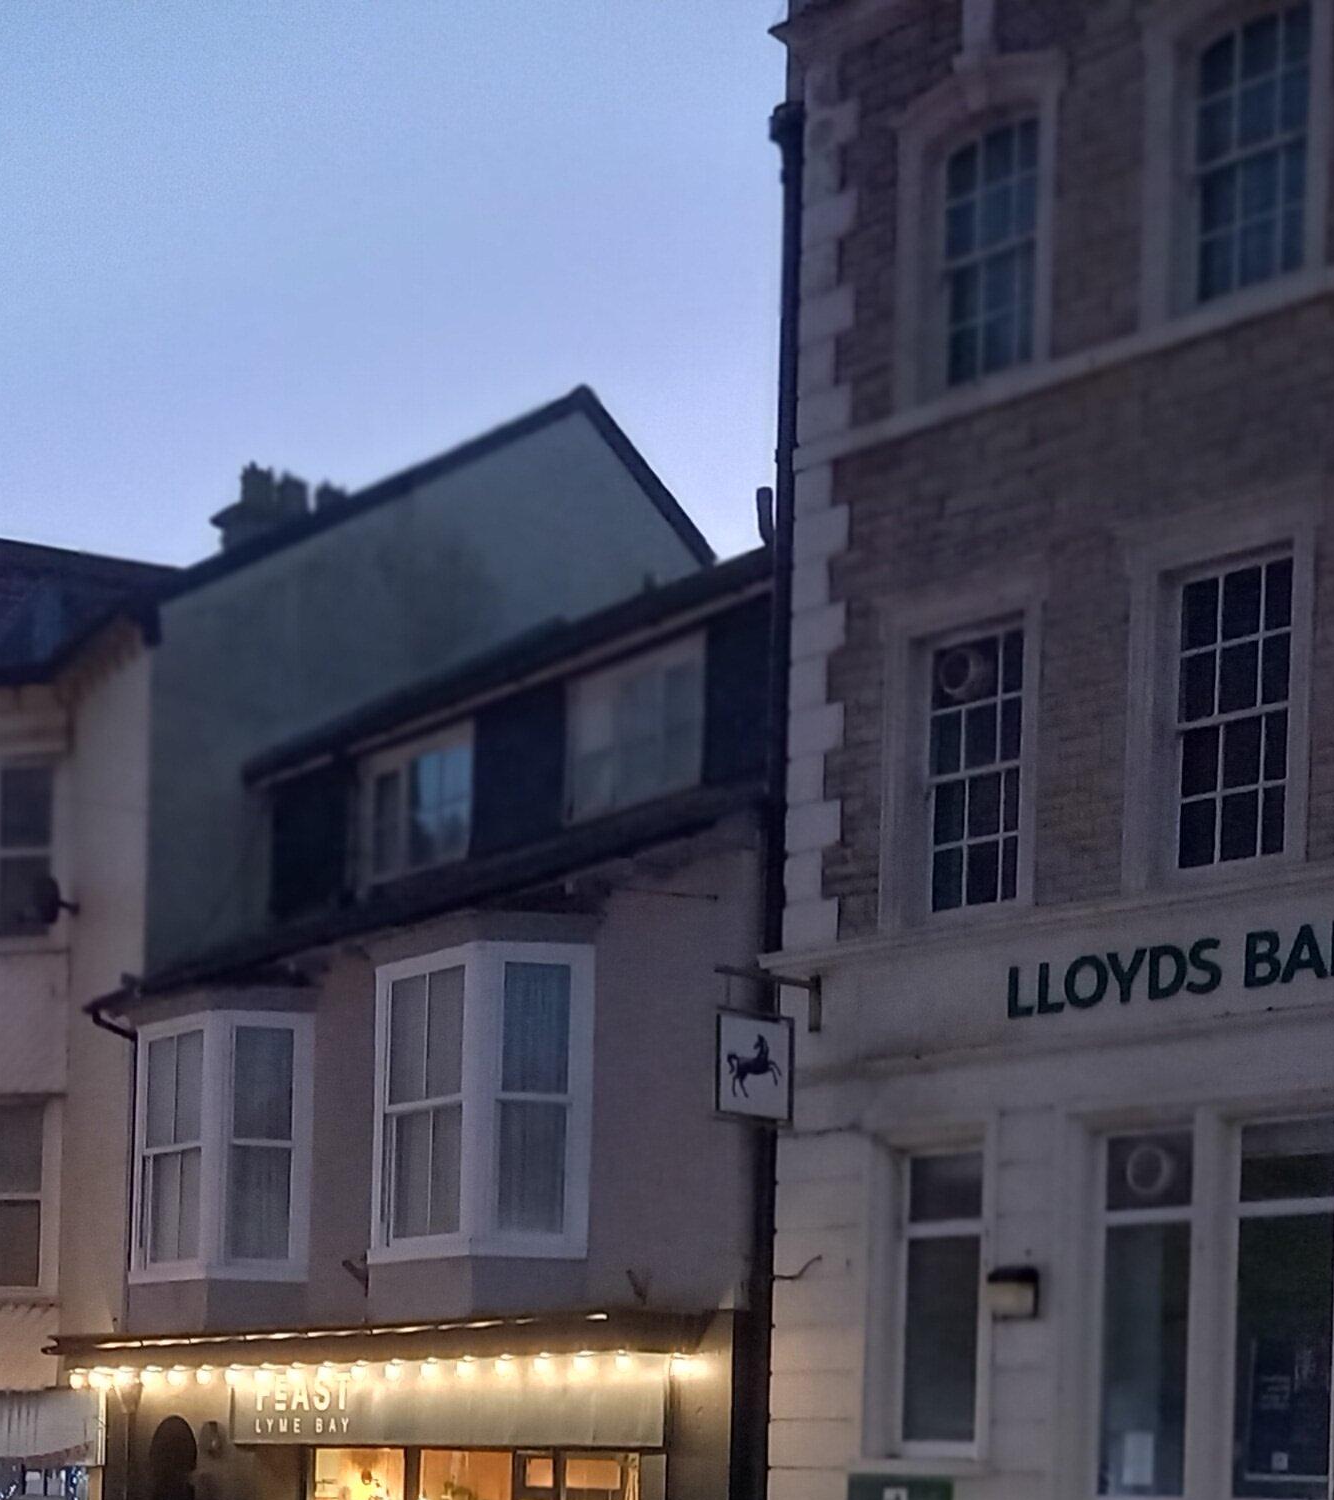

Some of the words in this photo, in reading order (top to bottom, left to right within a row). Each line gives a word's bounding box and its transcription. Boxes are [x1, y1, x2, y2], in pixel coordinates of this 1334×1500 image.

[1007, 937, 1222, 1019] LLOYDS
[254, 1371, 351, 1411] FEAST
[255, 1418, 302, 1433] LYME
[315, 1417, 350, 1433] BAY
